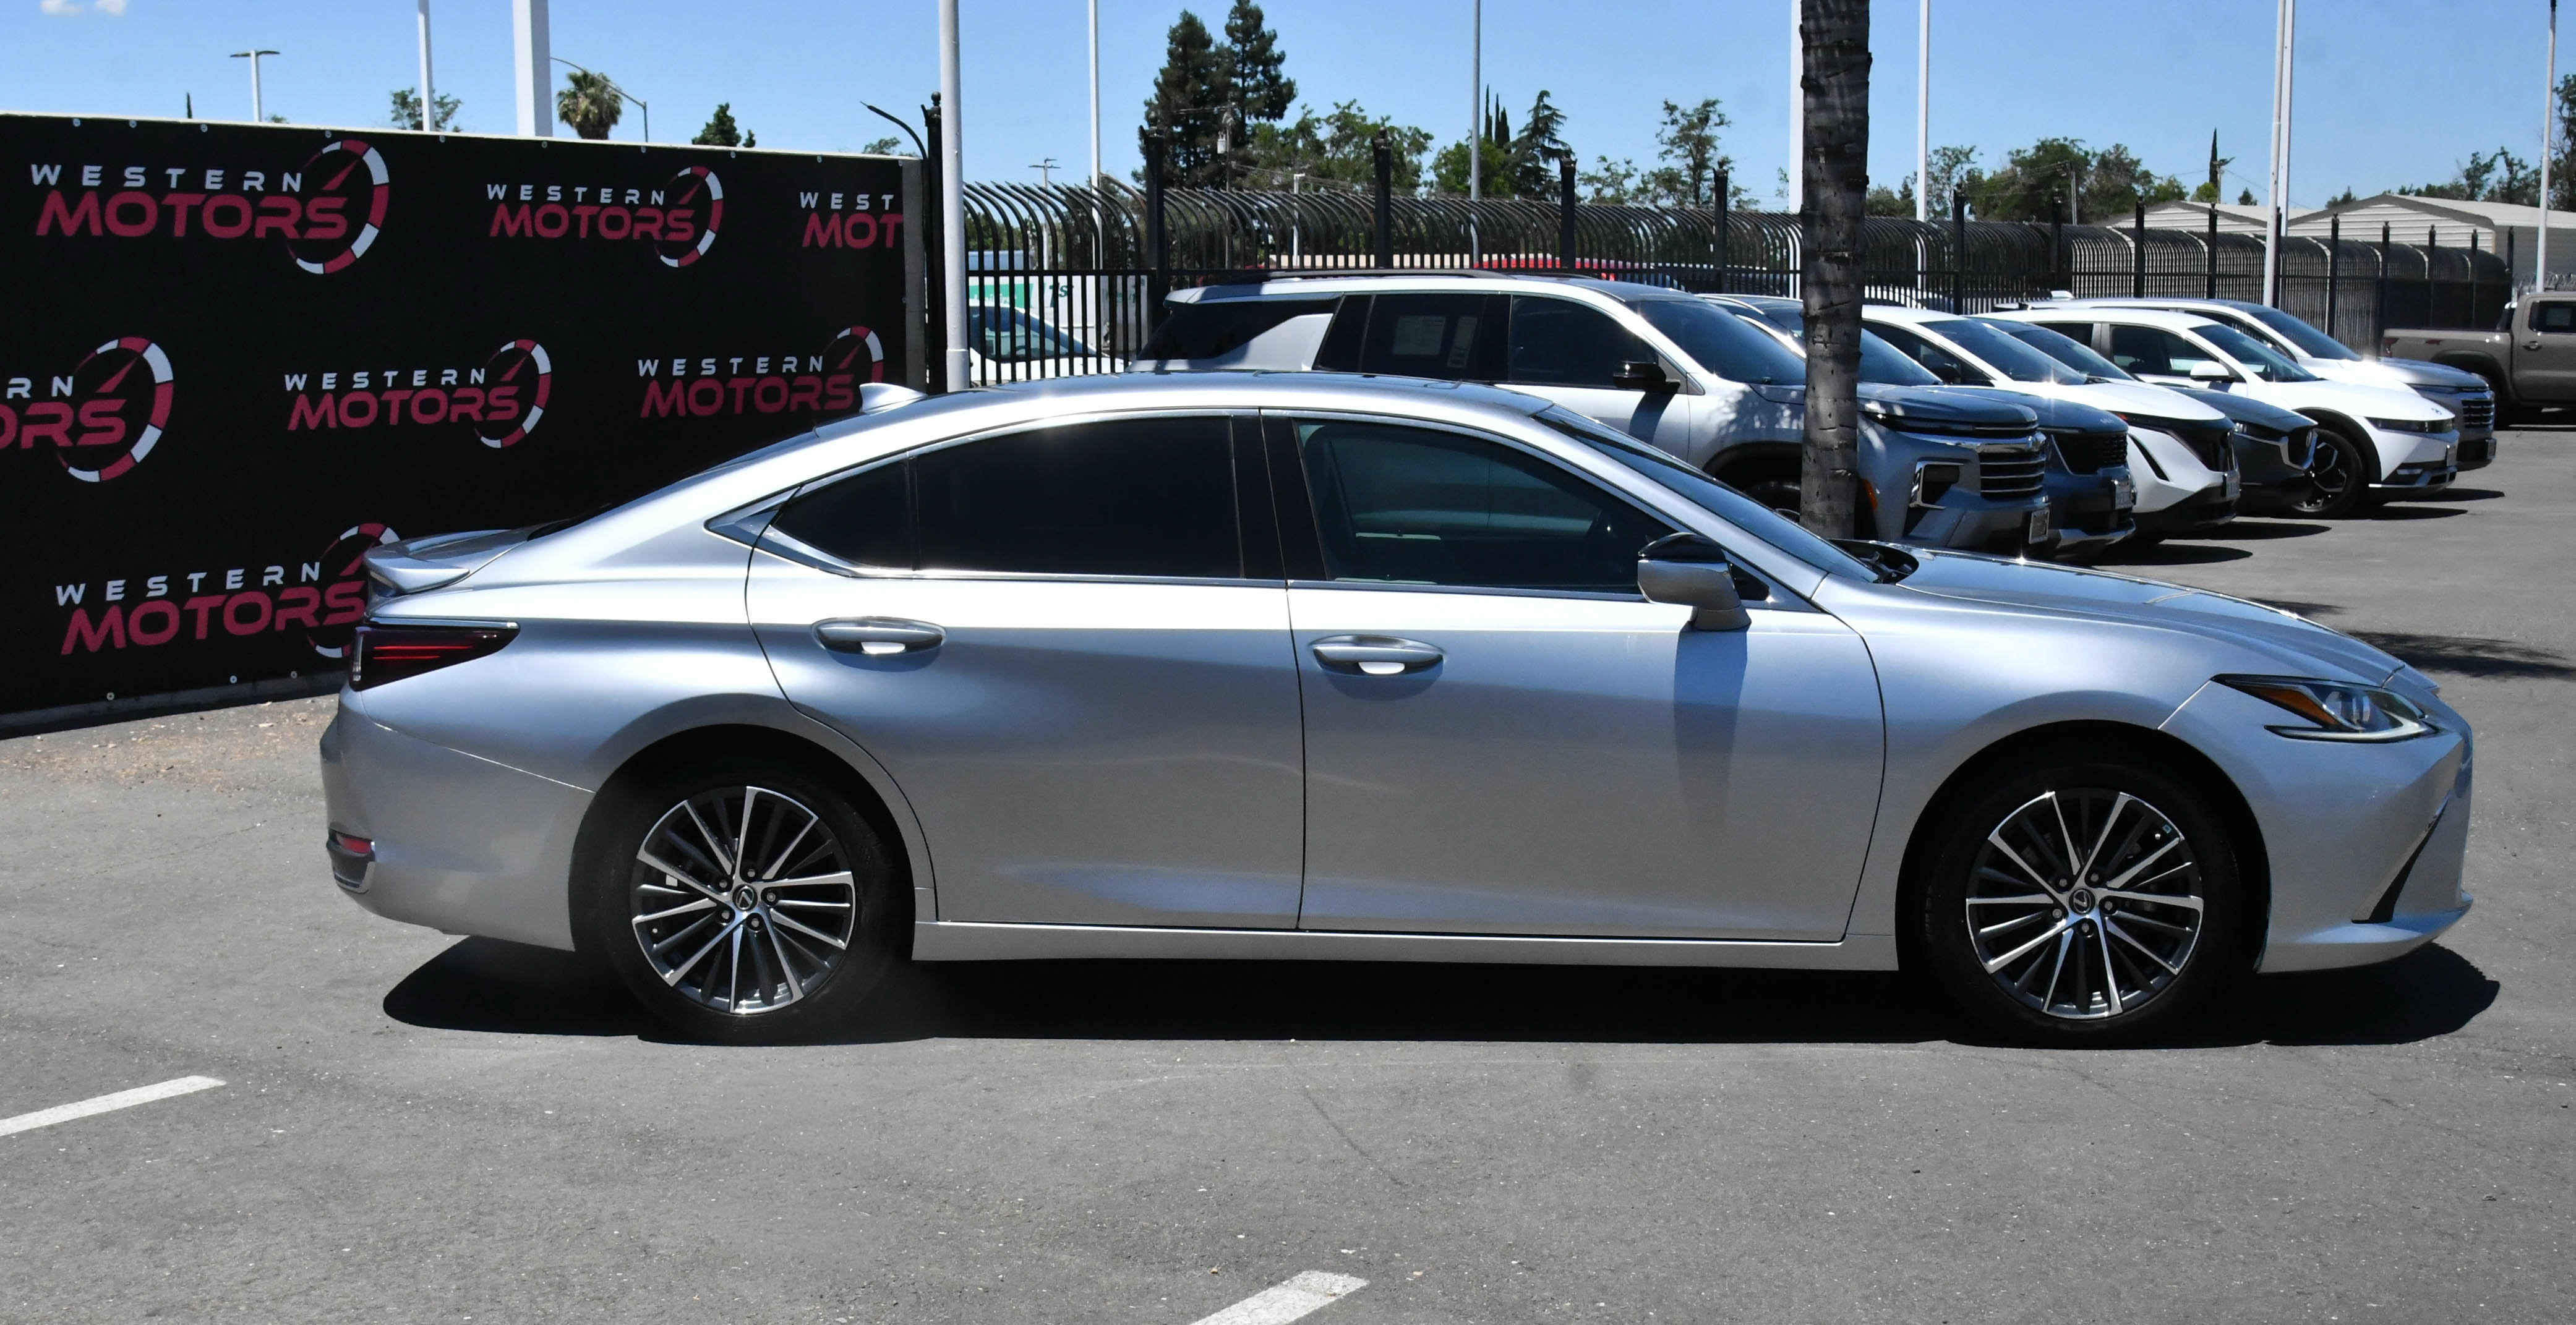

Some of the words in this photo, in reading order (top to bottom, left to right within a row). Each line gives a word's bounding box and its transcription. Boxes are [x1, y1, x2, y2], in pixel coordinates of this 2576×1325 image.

[31, 164, 302, 192] WESTERN
[487, 184, 664, 205] WESTERN
[36, 189, 347, 239] MOTORS
[800, 192, 894, 210] WEST
[490, 203, 695, 241] MOTORS
[285, 368, 485, 391] WESTERN
[638, 356, 823, 377] WESTERN
[288, 385, 519, 431] MOTORS
[641, 374, 854, 418] MOTORS
[56, 561, 320, 606] WESTERN
[61, 581, 367, 655] MOTORS
